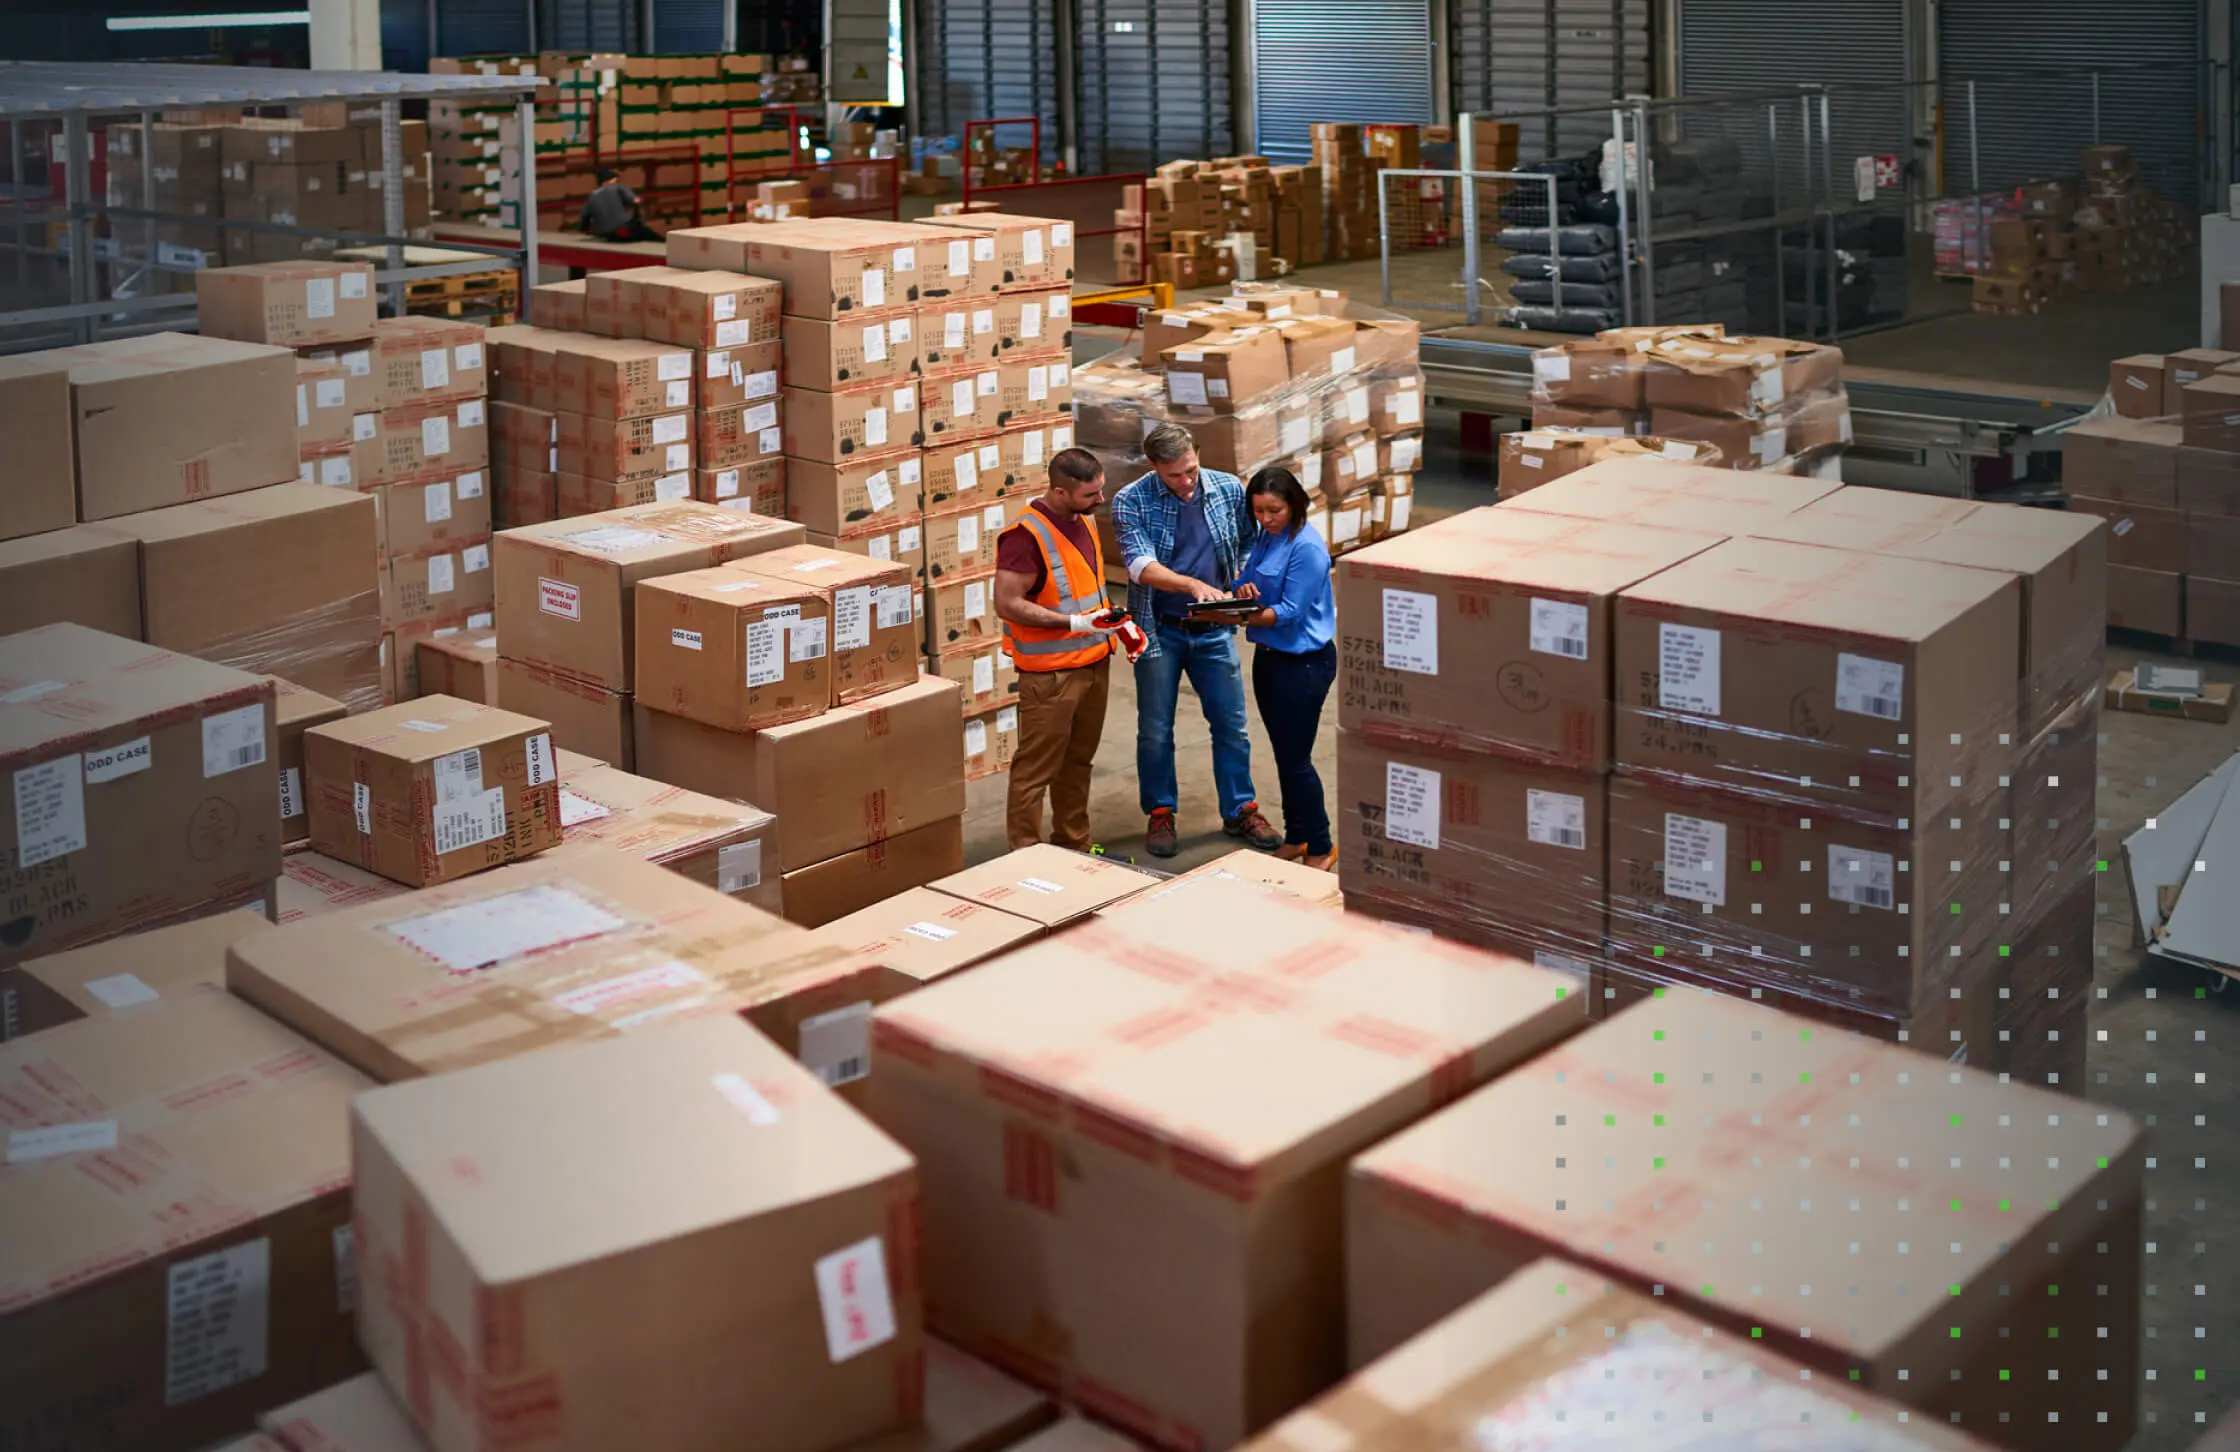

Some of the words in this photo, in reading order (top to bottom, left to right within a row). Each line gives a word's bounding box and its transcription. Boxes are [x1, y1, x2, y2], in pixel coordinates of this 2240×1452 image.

[764, 611, 779, 620] ODD
[781, 608, 800, 618] CASE
[672, 630, 685, 639] ODD
[686, 632, 701, 643] CASE
[86, 756, 113, 772] ODD
[116, 744, 149, 762] CASE
[530, 735, 539, 761] CASE
[280, 768, 289, 794] CASE
[533, 764, 541, 784] ODD
[282, 796, 292, 816] ODD
